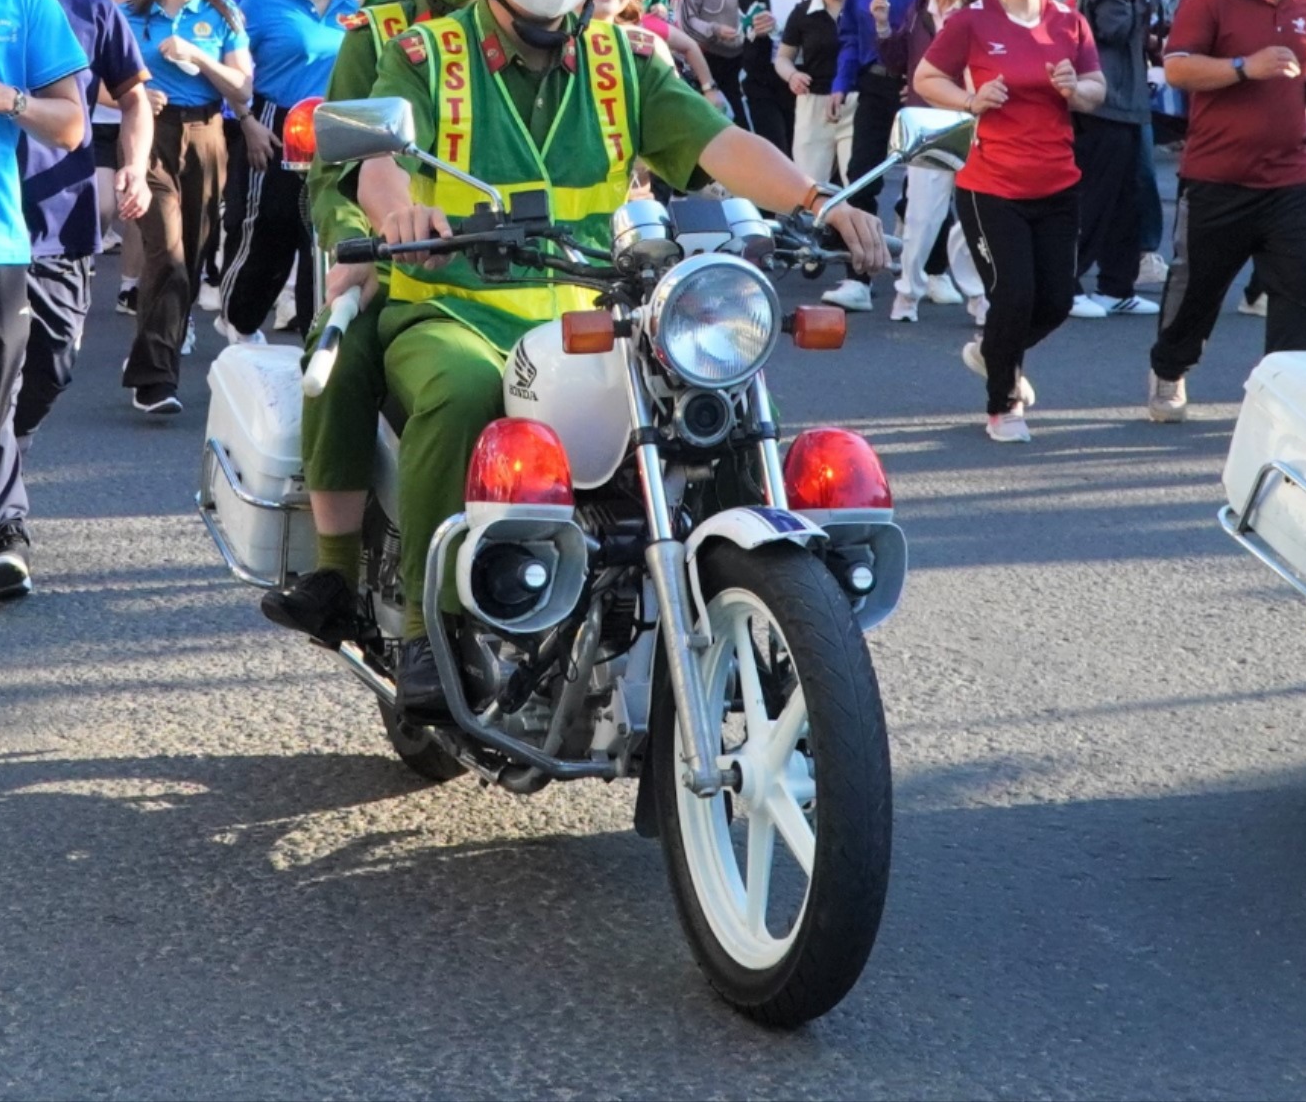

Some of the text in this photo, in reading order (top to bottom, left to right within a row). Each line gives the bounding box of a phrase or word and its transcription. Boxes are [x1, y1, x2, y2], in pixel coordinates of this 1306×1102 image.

[440, 31, 466, 163] CSTT
[591, 32, 625, 163] CSTT
[509, 384, 539, 402] HONDA
